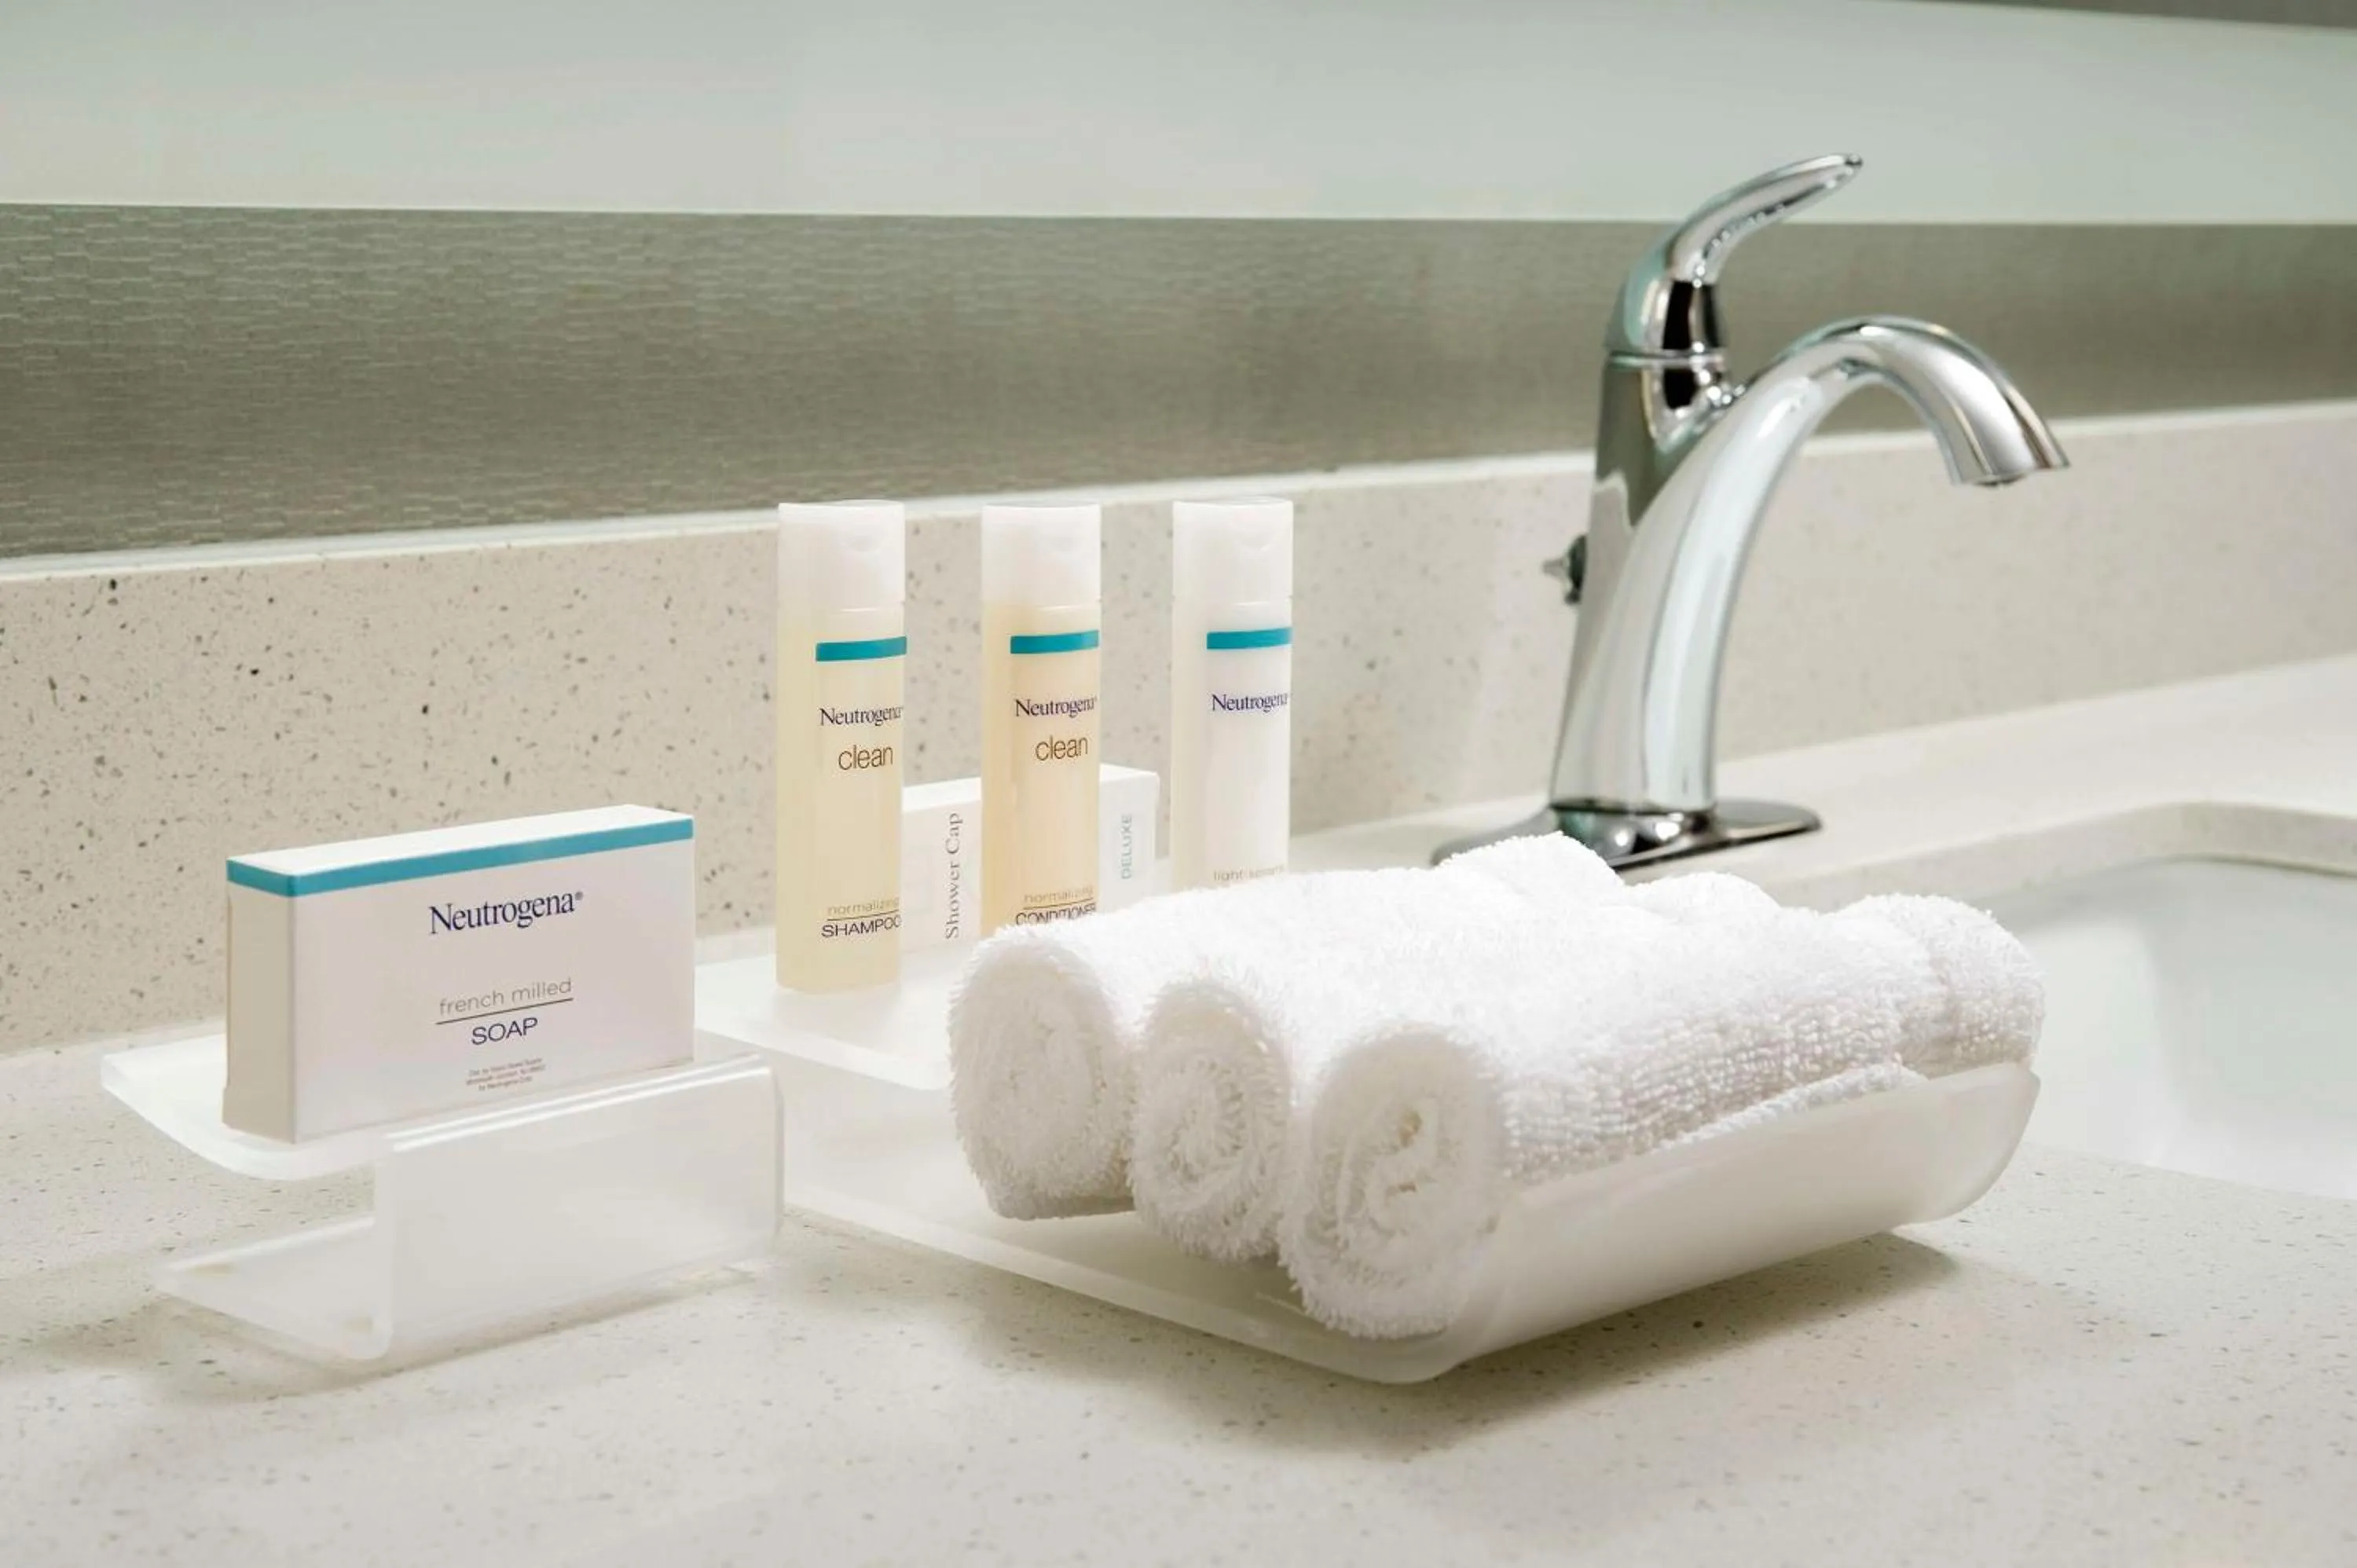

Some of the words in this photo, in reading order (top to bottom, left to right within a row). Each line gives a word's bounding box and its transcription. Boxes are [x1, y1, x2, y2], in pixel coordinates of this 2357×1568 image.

[838, 745, 893, 771] clean
[1035, 735, 1088, 760] clean
[945, 812, 963, 855] Cap
[1121, 813, 1132, 879] DELUXE
[945, 861, 960, 940] Shower
[439, 990, 504, 1015] french
[511, 976, 572, 1002] milled
[471, 1017, 538, 1045] SOAP
